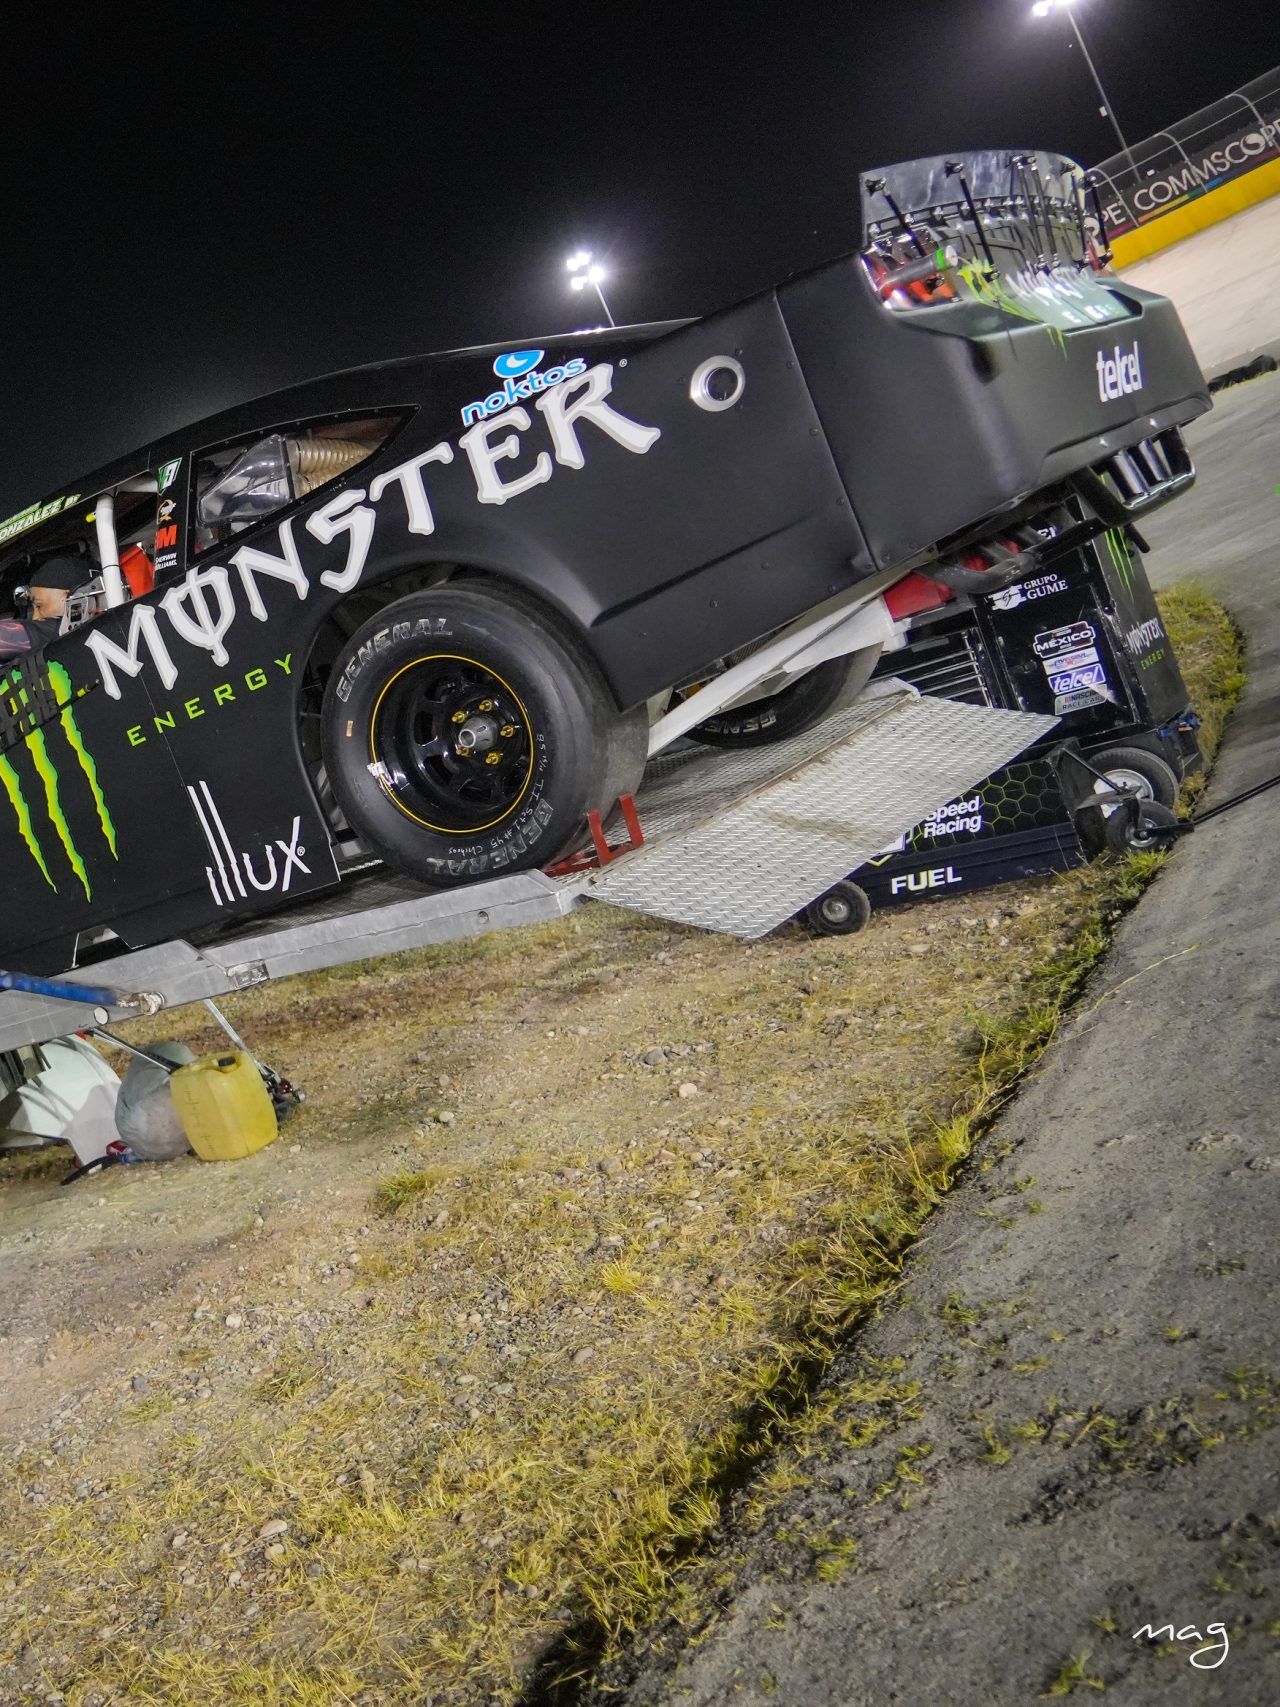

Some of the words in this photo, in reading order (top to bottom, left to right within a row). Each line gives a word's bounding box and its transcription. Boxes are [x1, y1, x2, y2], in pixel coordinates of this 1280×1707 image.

[1096, 341, 1143, 402] telcel
[463, 357, 587, 425] noktos
[1024, 574, 1058, 590] GRUPO
[1027, 580, 1068, 600] GUME
[336, 618, 453, 702] GENERAL
[1054, 665, 1100, 693] telcel
[126, 653, 293, 747] ENERGY
[923, 815, 982, 838] Racing
[891, 867, 962, 895] FUEL
